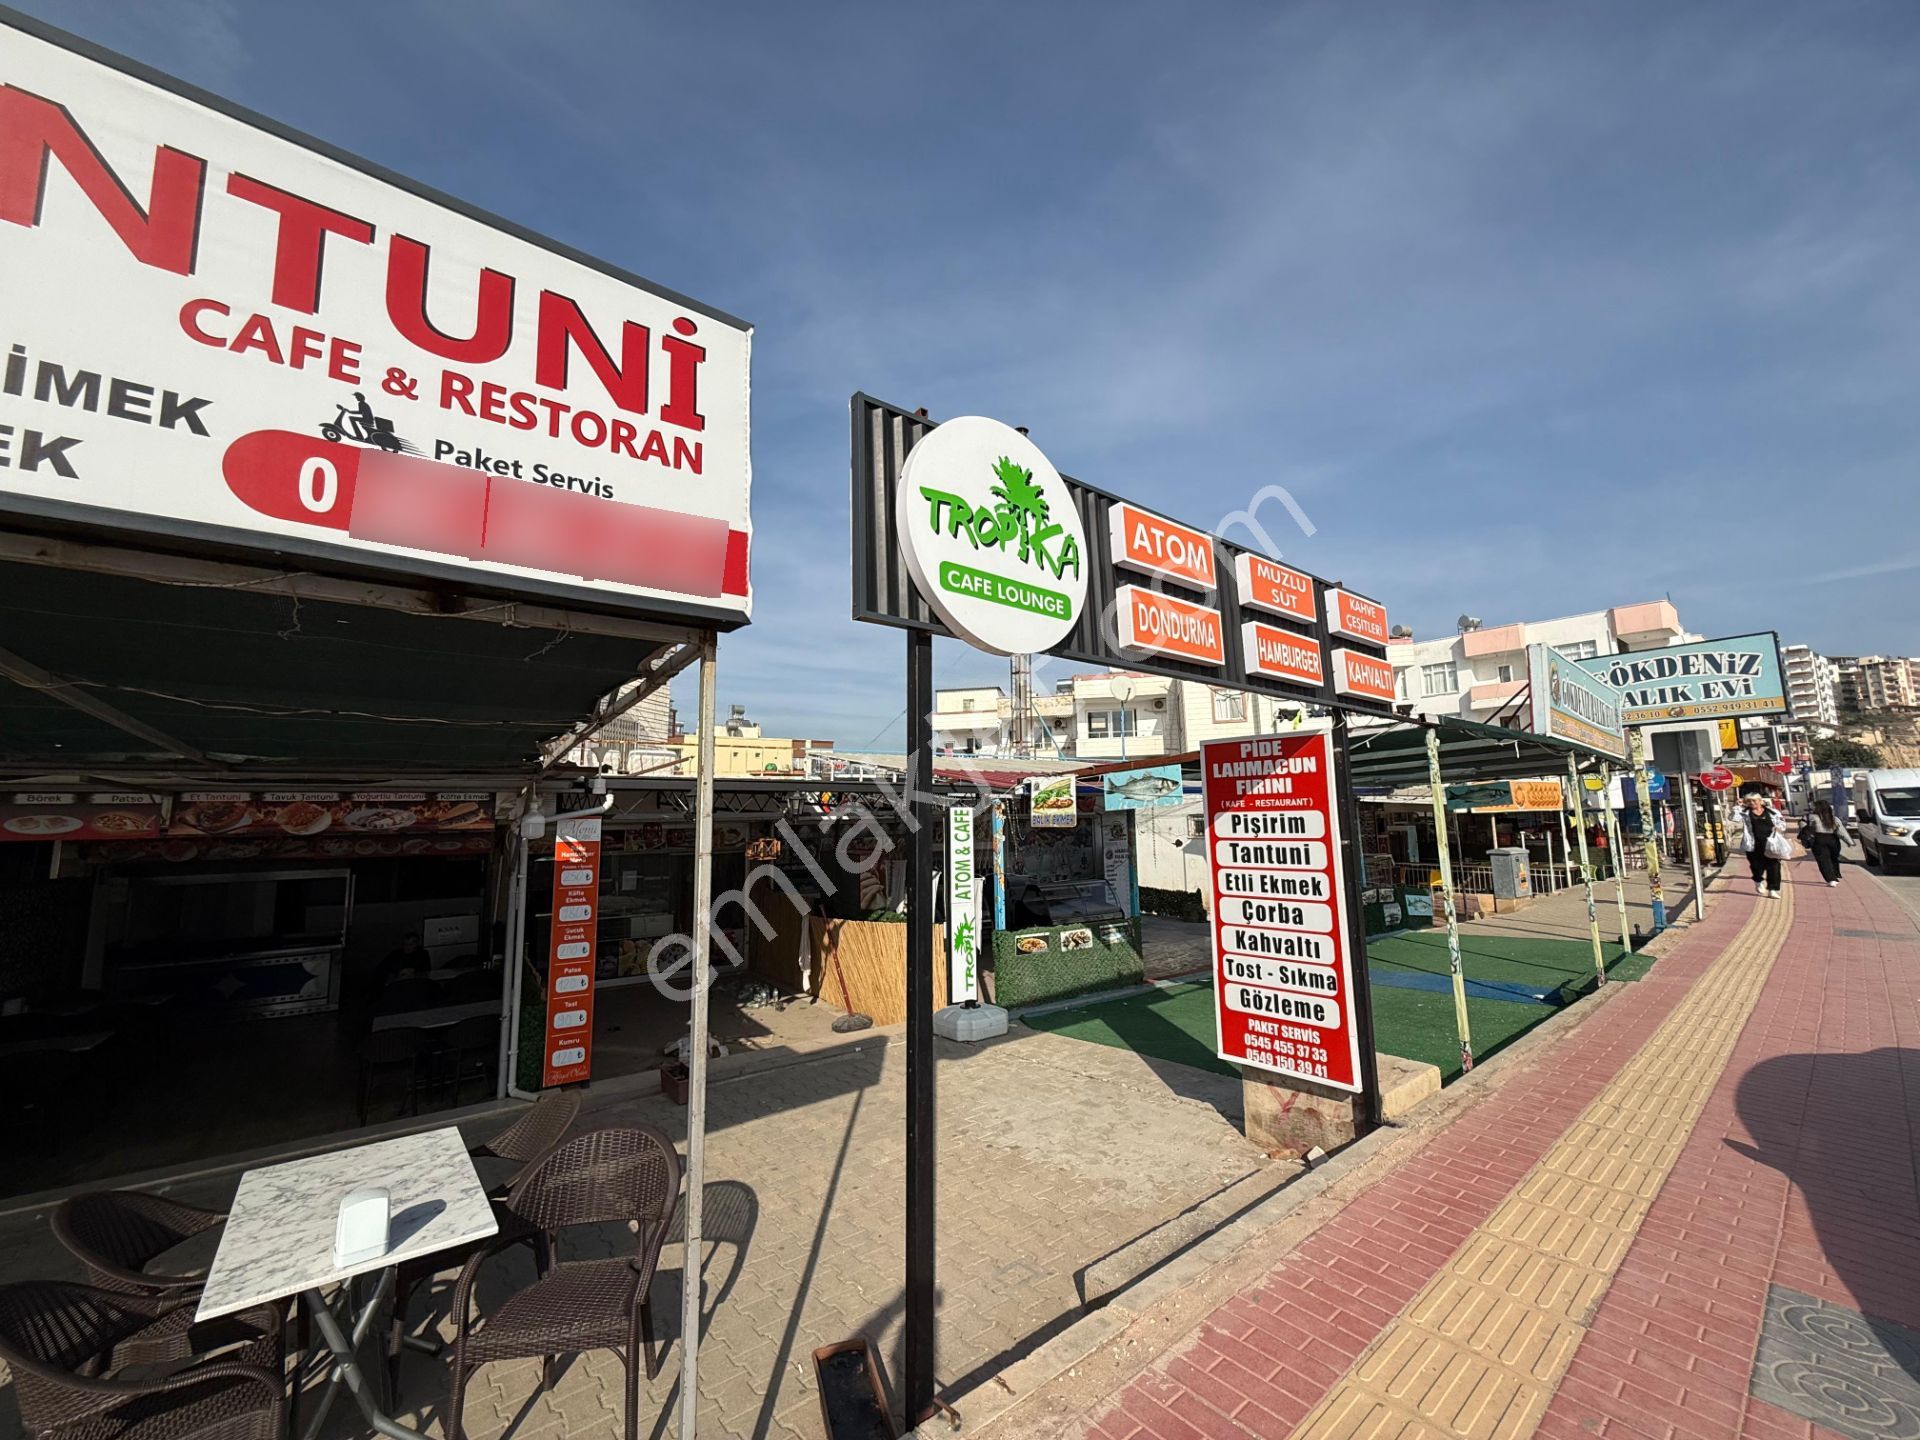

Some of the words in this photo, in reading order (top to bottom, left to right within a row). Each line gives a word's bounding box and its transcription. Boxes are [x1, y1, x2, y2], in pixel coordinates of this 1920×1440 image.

[3, 343, 214, 438] İMEK
[179, 298, 363, 386] CAFE
[381, 367, 419, 401] &
[439, 369, 702, 475] RESTORAN
[434, 438, 523, 479] Paket
[532, 463, 614, 500] Servis
[1133, 522, 1209, 575] ATOM
[1257, 563, 1307, 593] MUZLU
[947, 570, 992, 596] CAFE
[997, 583, 1064, 615] LOUNGE
[1271, 588, 1298, 609] SÜT
[1349, 599, 1377, 618] KAHVE
[1138, 602, 1217, 649] DONDURMA
[1345, 614, 1383, 637] ÇEŞİTLERİ
[1258, 638, 1321, 675] HAMBURGER
[1348, 660, 1393, 691] KAHVALTI
[1622, 685, 1693, 707] ALIK
[1693, 705, 1718, 714] 0552
[1722, 703, 1742, 712] 949
[1745, 701, 1757, 710] 31
[1240, 740, 1283, 759] PİDE
[1212, 756, 1317, 779] LAHMACUN
[26, 794, 62, 803] Börek
[111, 794, 144, 803] Patso
[189, 793, 201, 802] Et
[205, 793, 242, 802] Tantuni
[271, 793, 297, 801] Tavuk
[300, 793, 335, 801] Tantuni
[1236, 777, 1293, 796] FIRINI
[953, 809, 971, 842] CAFE
[1231, 813, 1306, 838] Pişirim
[954, 847, 971, 856] &
[1229, 842, 1312, 866] Tantuni
[954, 859, 972, 900] ATOM
[1225, 872, 1255, 893] Etli
[1260, 874, 1323, 897] Ekmek
[1242, 899, 1305, 926] Çorba
[1235, 929, 1322, 960] Kahvaltı
[1226, 958, 1263, 981] Tost
[1279, 965, 1338, 992] Sıkma
[1240, 988, 1326, 1022] Gözleme
[1248, 1018, 1280, 1037] PAKET
[1281, 1026, 1321, 1046] SERVİS
[1244, 1033, 1272, 1051] 0545
[1273, 1038, 1295, 1056] 455
[1296, 1044, 1310, 1058] 37
[1311, 1047, 1328, 1063] 33
[1245, 1047, 1274, 1067] 0549
[1275, 1052, 1296, 1072] 150
[1296, 1060, 1313, 1076] 39
[1314, 1064, 1328, 1079] 41
